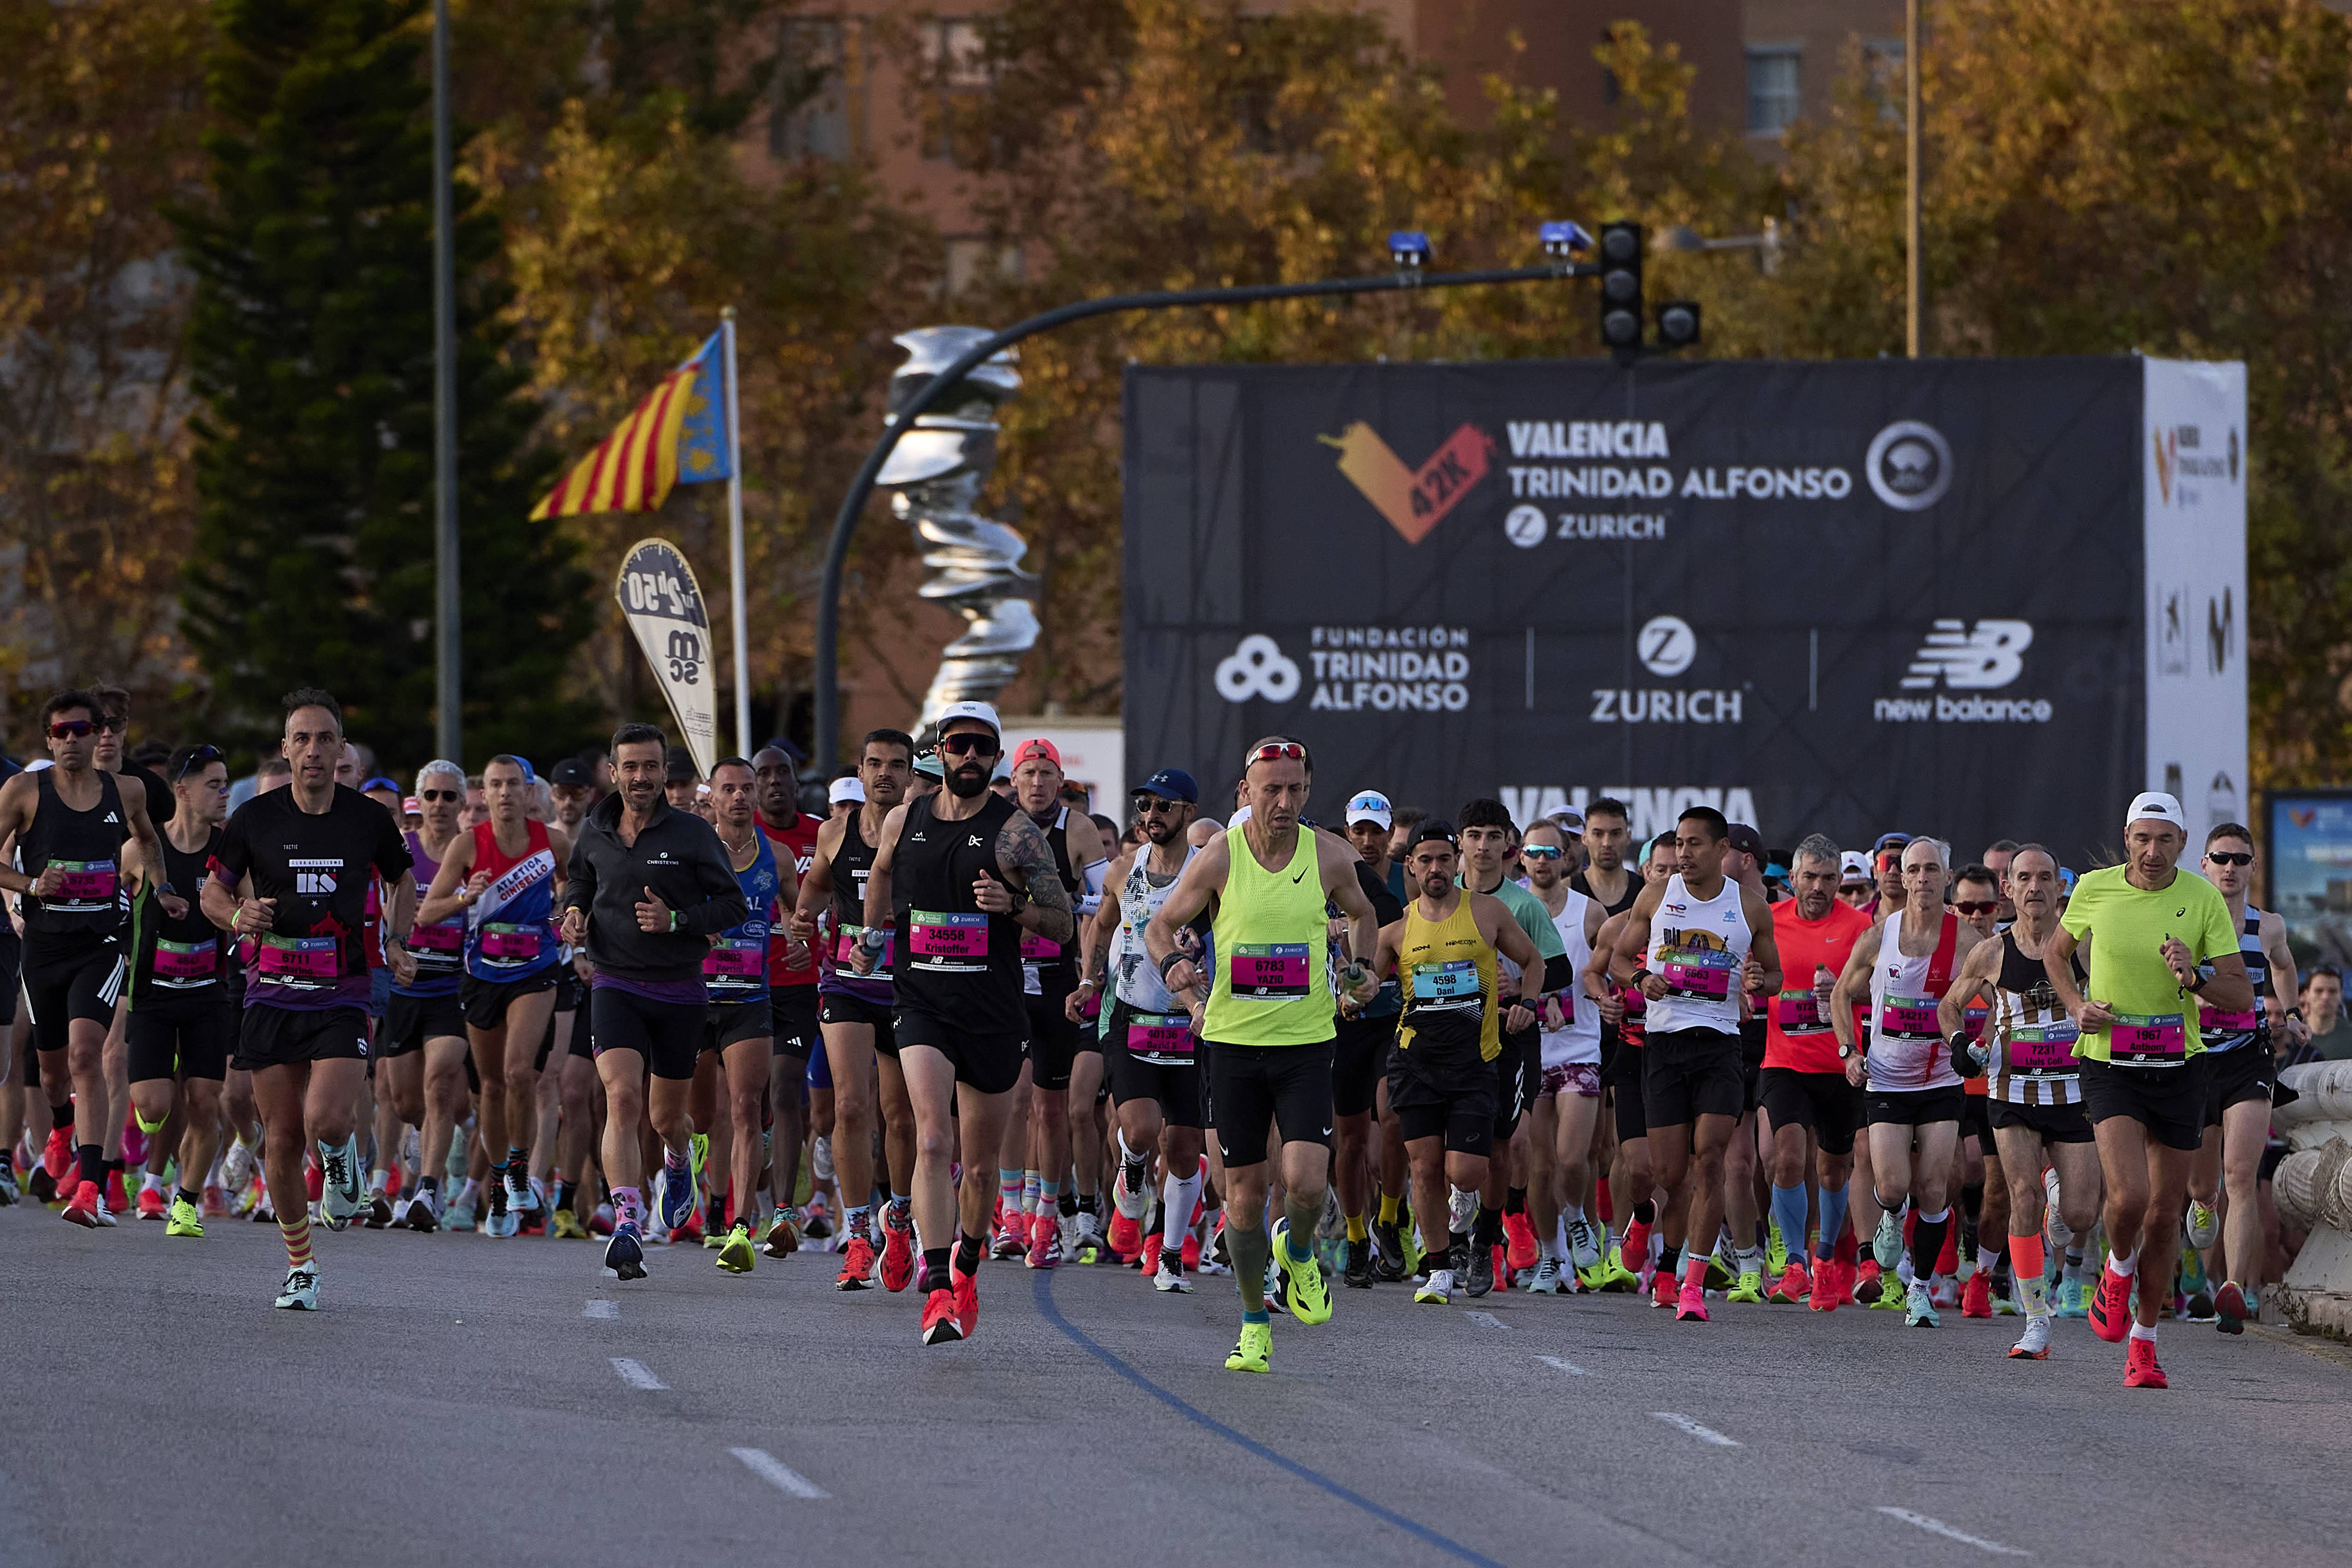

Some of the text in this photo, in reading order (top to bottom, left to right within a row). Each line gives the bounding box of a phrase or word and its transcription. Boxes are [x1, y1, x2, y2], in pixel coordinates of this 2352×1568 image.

[1506, 421, 1669, 458] VALENCIA
[1410, 450, 1471, 517] 42K
[1507, 467, 1852, 499] TRINIDAD ALFONSO
[1556, 515, 1665, 539] ZURICH
[1311, 626, 1469, 647] FUNDACIÓN
[1309, 651, 1469, 680] TRINIDAD
[1310, 683, 1469, 711] ALFONSO
[1590, 689, 1742, 723] ZURICH
[1874, 695, 2052, 723] new balance
[497, 857, 541, 893] ATLETICA
[500, 864, 548, 901] CINISELLO
[929, 929, 965, 940] 34558
[926, 943, 970, 953] Kristoffer
[282, 953, 309, 964] 6711
[718, 952, 742, 962] 5802
[1255, 960, 1284, 972] 6783
[1257, 975, 1283, 984] YAZID
[1433, 974, 1456, 985] 4598
[1685, 968, 1709, 980] 6663
[1683, 980, 1708, 990] Marco
[1437, 986, 1455, 996] Dani
[1899, 1010, 1929, 1021] 34212
[1903, 1022, 1923, 1030] YVES
[1147, 1029, 1177, 1039] 40136
[2136, 1029, 2162, 1040] 1967
[2031, 1045, 2055, 1055] 7231
[2130, 1043, 2166, 1052] Anthony
[2047, 1057, 2063, 1065] Coll
